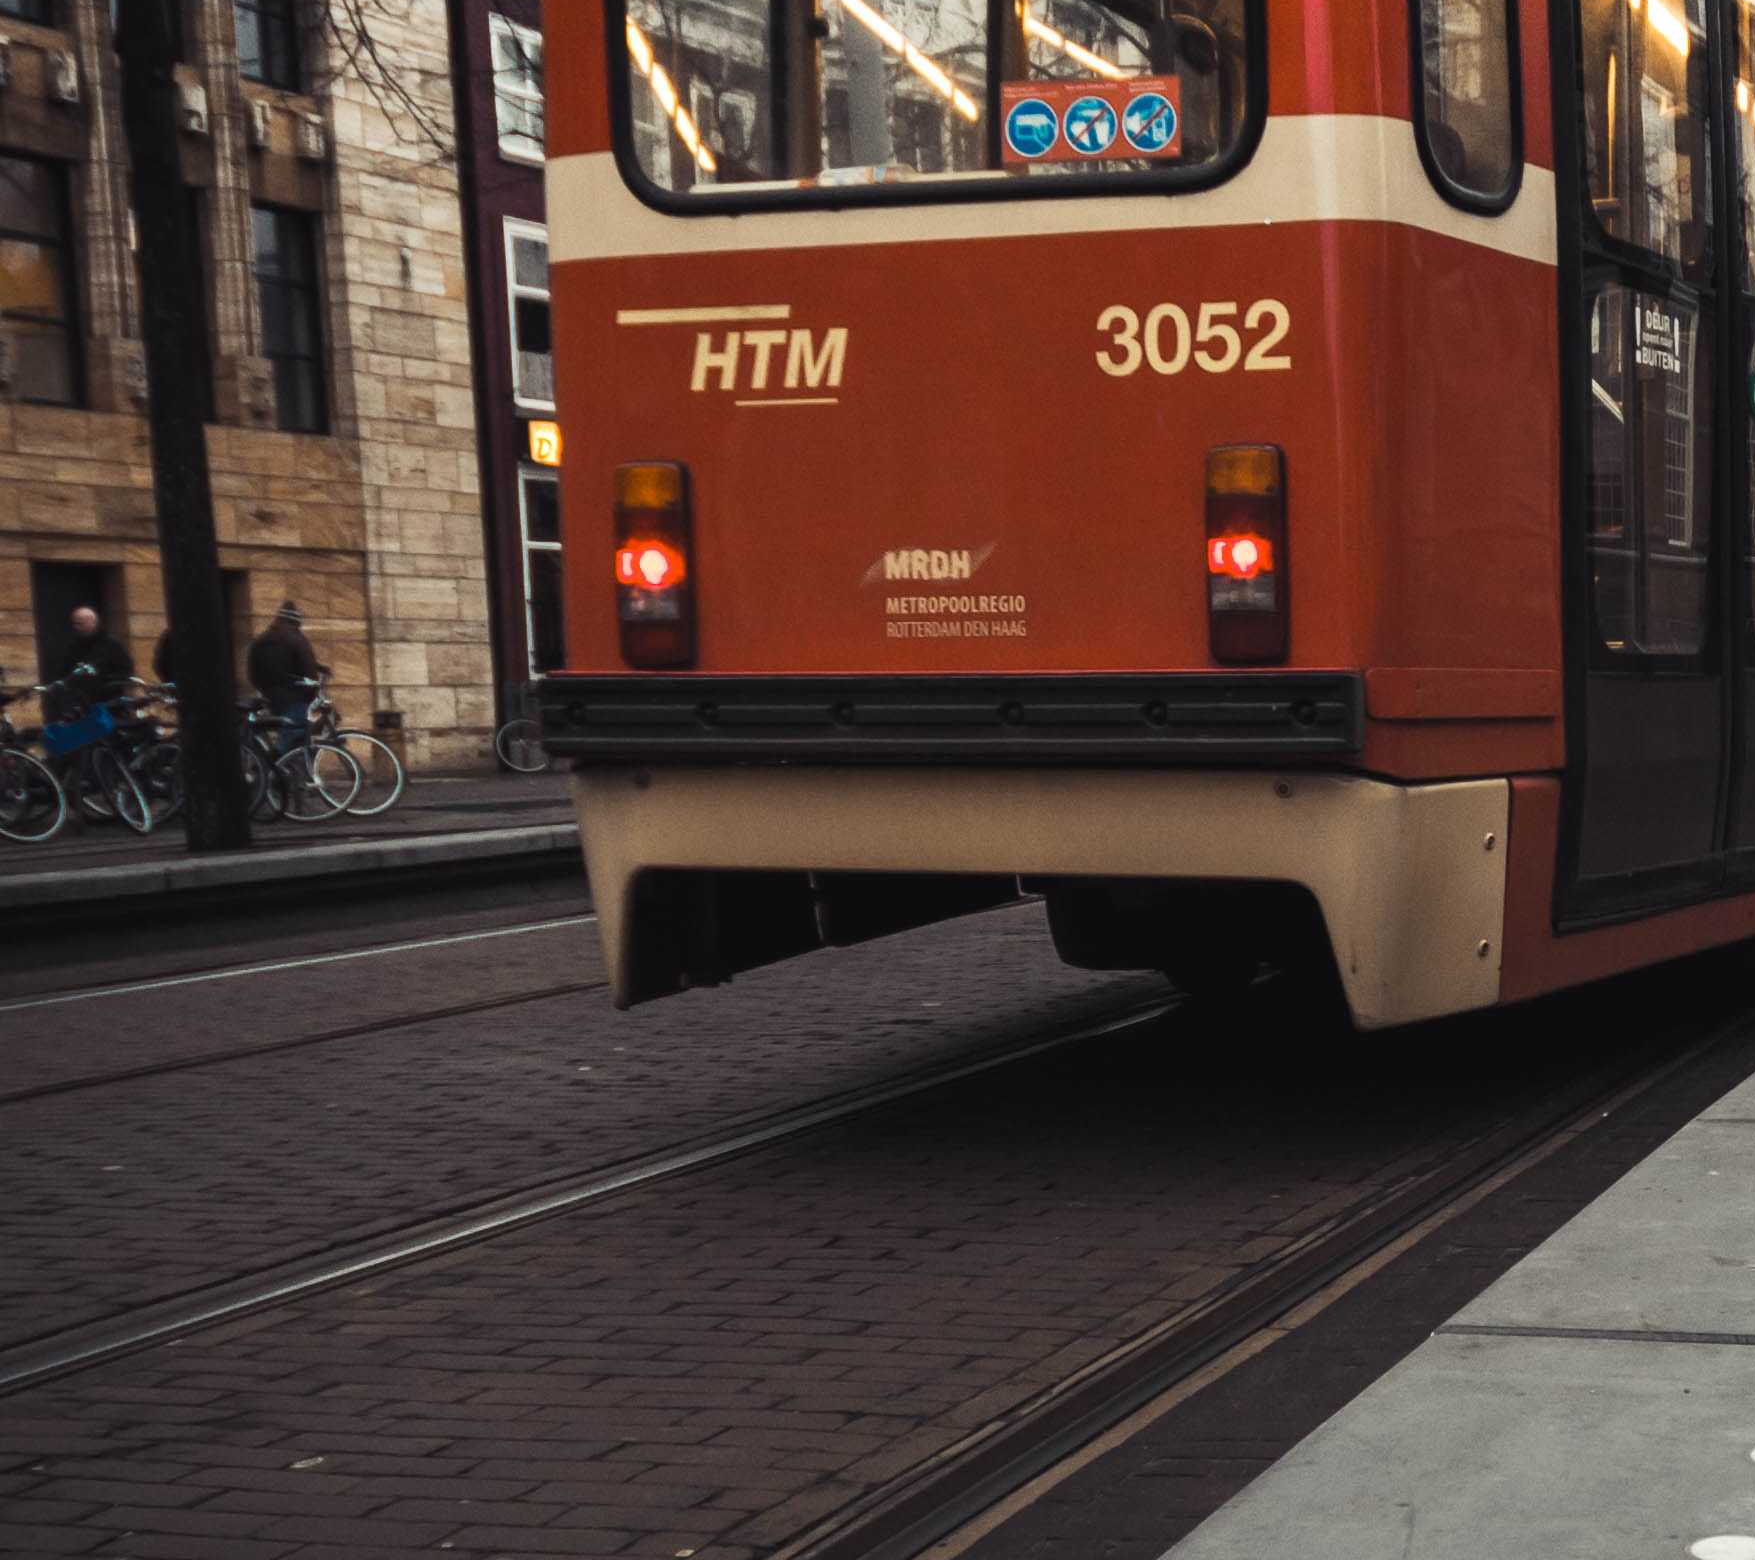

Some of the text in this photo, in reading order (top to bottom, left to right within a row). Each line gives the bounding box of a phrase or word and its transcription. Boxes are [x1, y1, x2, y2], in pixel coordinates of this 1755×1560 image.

[1645, 309, 1671, 334] DEUR
[1095, 298, 1292, 377] 3052
[690, 327, 849, 392] HTM
[1641, 346, 1674, 372] BUITEN
[884, 549, 971, 580] MRDH
[885, 595, 1026, 615] METROPOOLREGIO
[886, 619, 1027, 638] ROTTERDAM DEN HAAG
